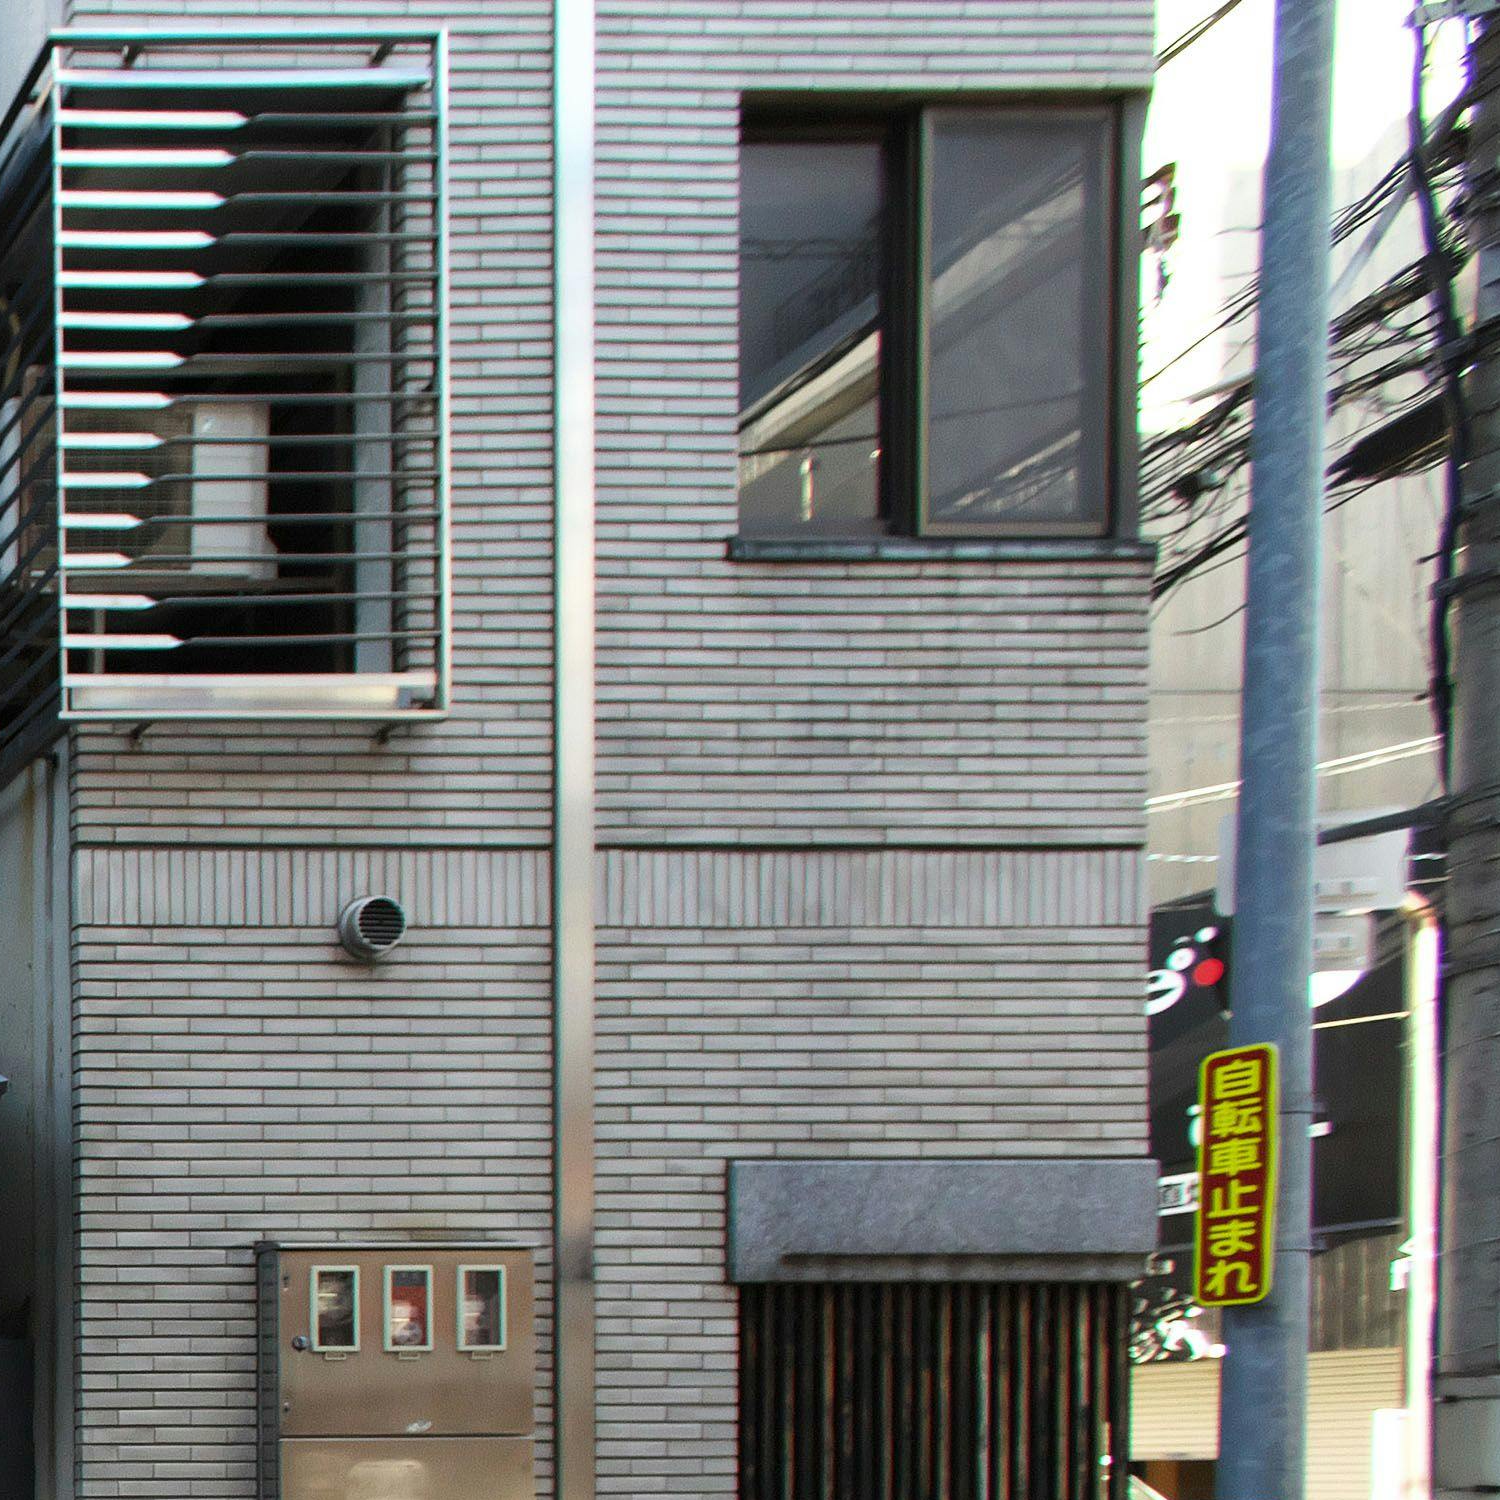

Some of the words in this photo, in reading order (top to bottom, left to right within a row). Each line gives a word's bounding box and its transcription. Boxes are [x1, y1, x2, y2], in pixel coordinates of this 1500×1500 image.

[1201, 1058, 1263, 1297] 自転車止まれ
